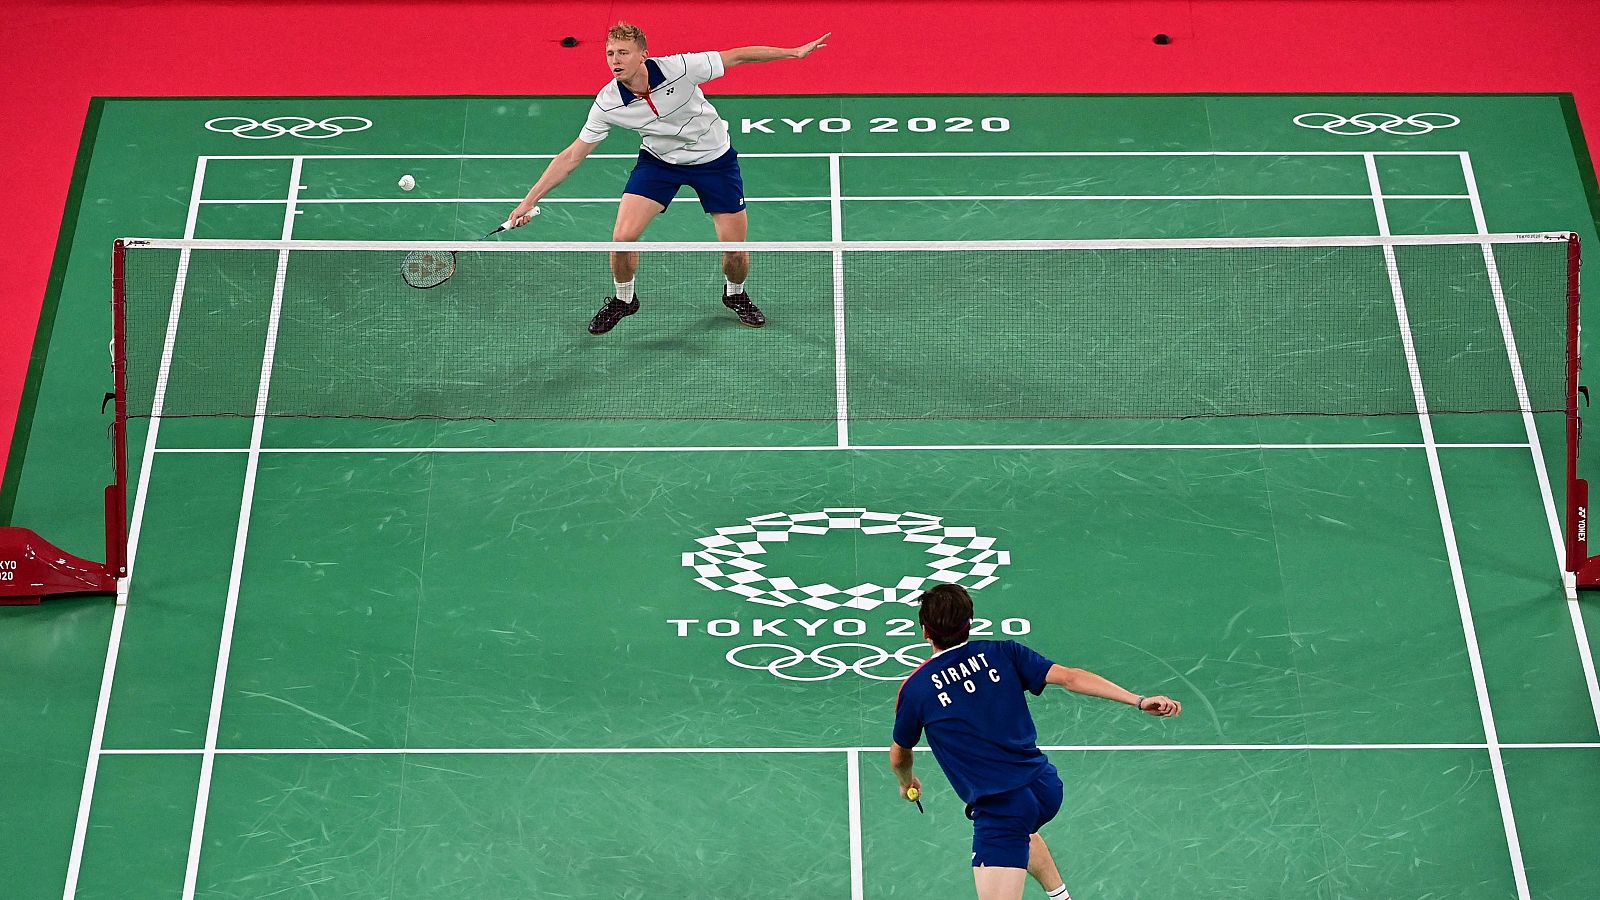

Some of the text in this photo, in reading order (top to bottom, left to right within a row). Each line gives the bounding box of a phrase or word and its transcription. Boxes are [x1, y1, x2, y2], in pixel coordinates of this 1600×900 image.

[721, 117, 1011, 133] KYO 2020
[1577, 520, 1586, 542] YONEX
[666, 618, 1032, 637] TOKYO 220
[931, 653, 989, 690] SIRANT
